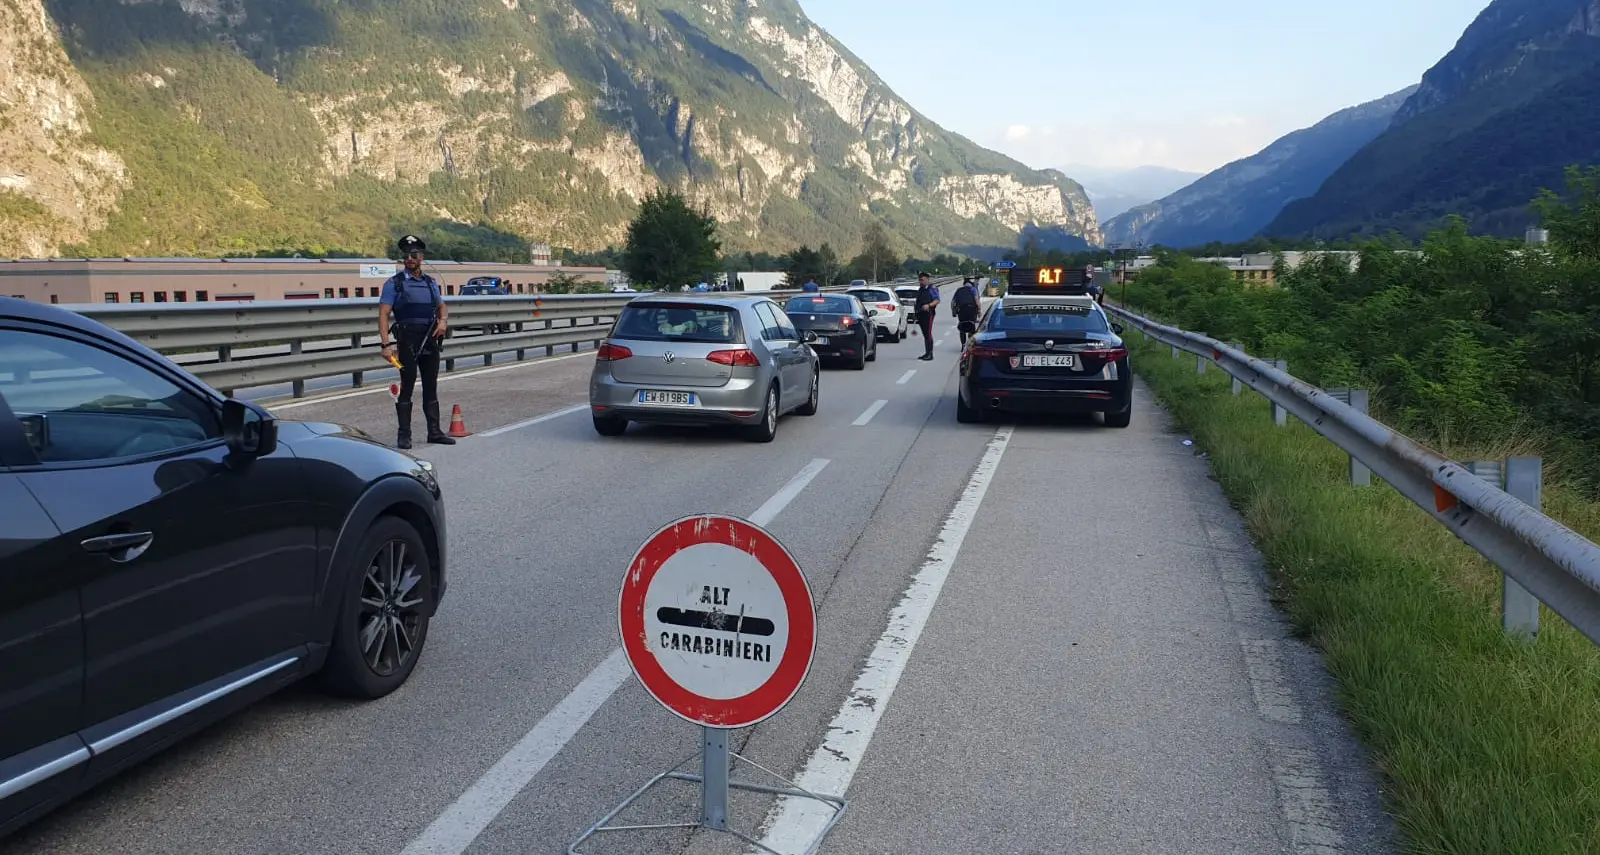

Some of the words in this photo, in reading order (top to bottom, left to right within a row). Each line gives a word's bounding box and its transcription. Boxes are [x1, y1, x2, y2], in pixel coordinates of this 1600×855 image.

[1038, 268, 1062, 284] ALT
[700, 585, 731, 606] ALT
[660, 631, 771, 663] CARABINIERI
